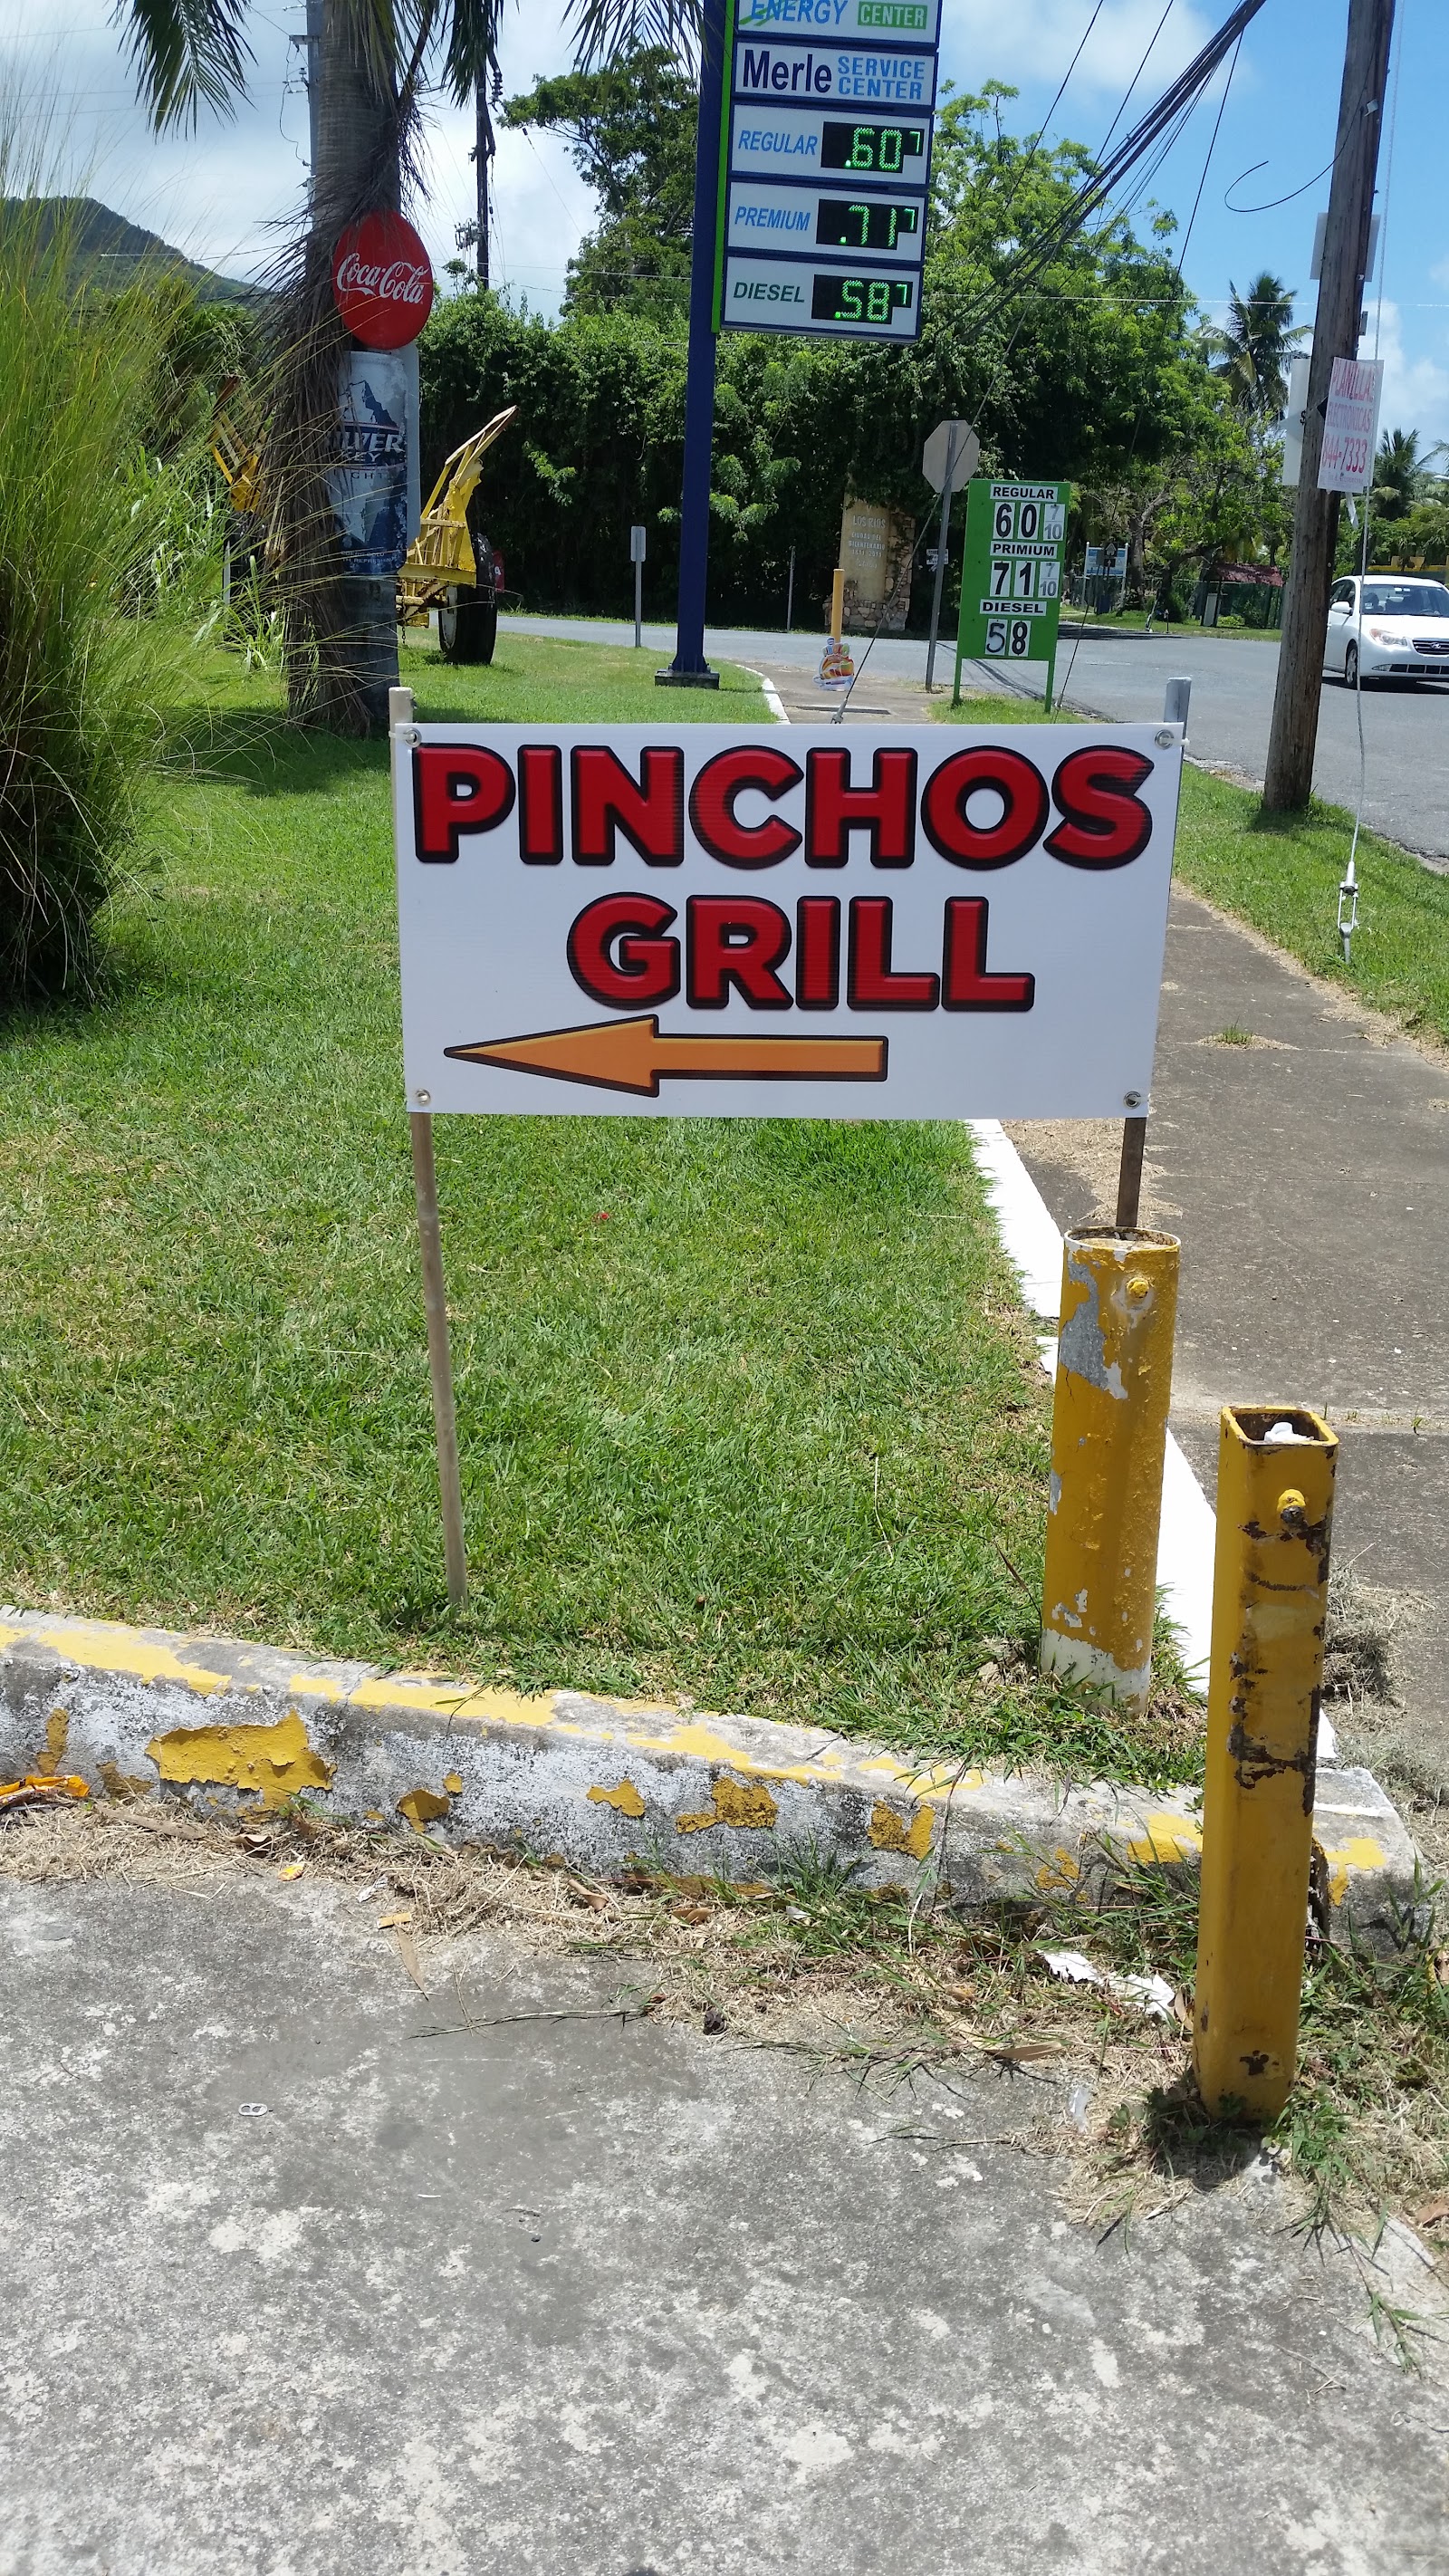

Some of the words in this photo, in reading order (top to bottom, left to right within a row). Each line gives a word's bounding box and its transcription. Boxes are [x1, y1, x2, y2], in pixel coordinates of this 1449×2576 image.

[751, 0, 848, 24] ENERGY
[860, 4, 925, 27] CENTER
[743, 49, 832, 92] Merle
[838, 56, 925, 80] SERVICE
[838, 76, 922, 100] CENTER
[738, 130, 817, 155] REGULAR
[734, 206, 811, 231] PREMIUM
[337, 253, 429, 304] Coca-Cola
[734, 282, 805, 303] DIESEL
[993, 487, 1054, 499] REGULAR
[853, 515, 867, 527] LOS
[996, 503, 1037, 539] 60
[993, 544, 1055, 556] PRIMIUM
[993, 562, 1032, 596] 71
[983, 602, 1044, 613] DIESEL
[986, 621, 1028, 655] 58
[411, 743, 1156, 870] PINCHOS
[566, 891, 1035, 1012] GRILL
